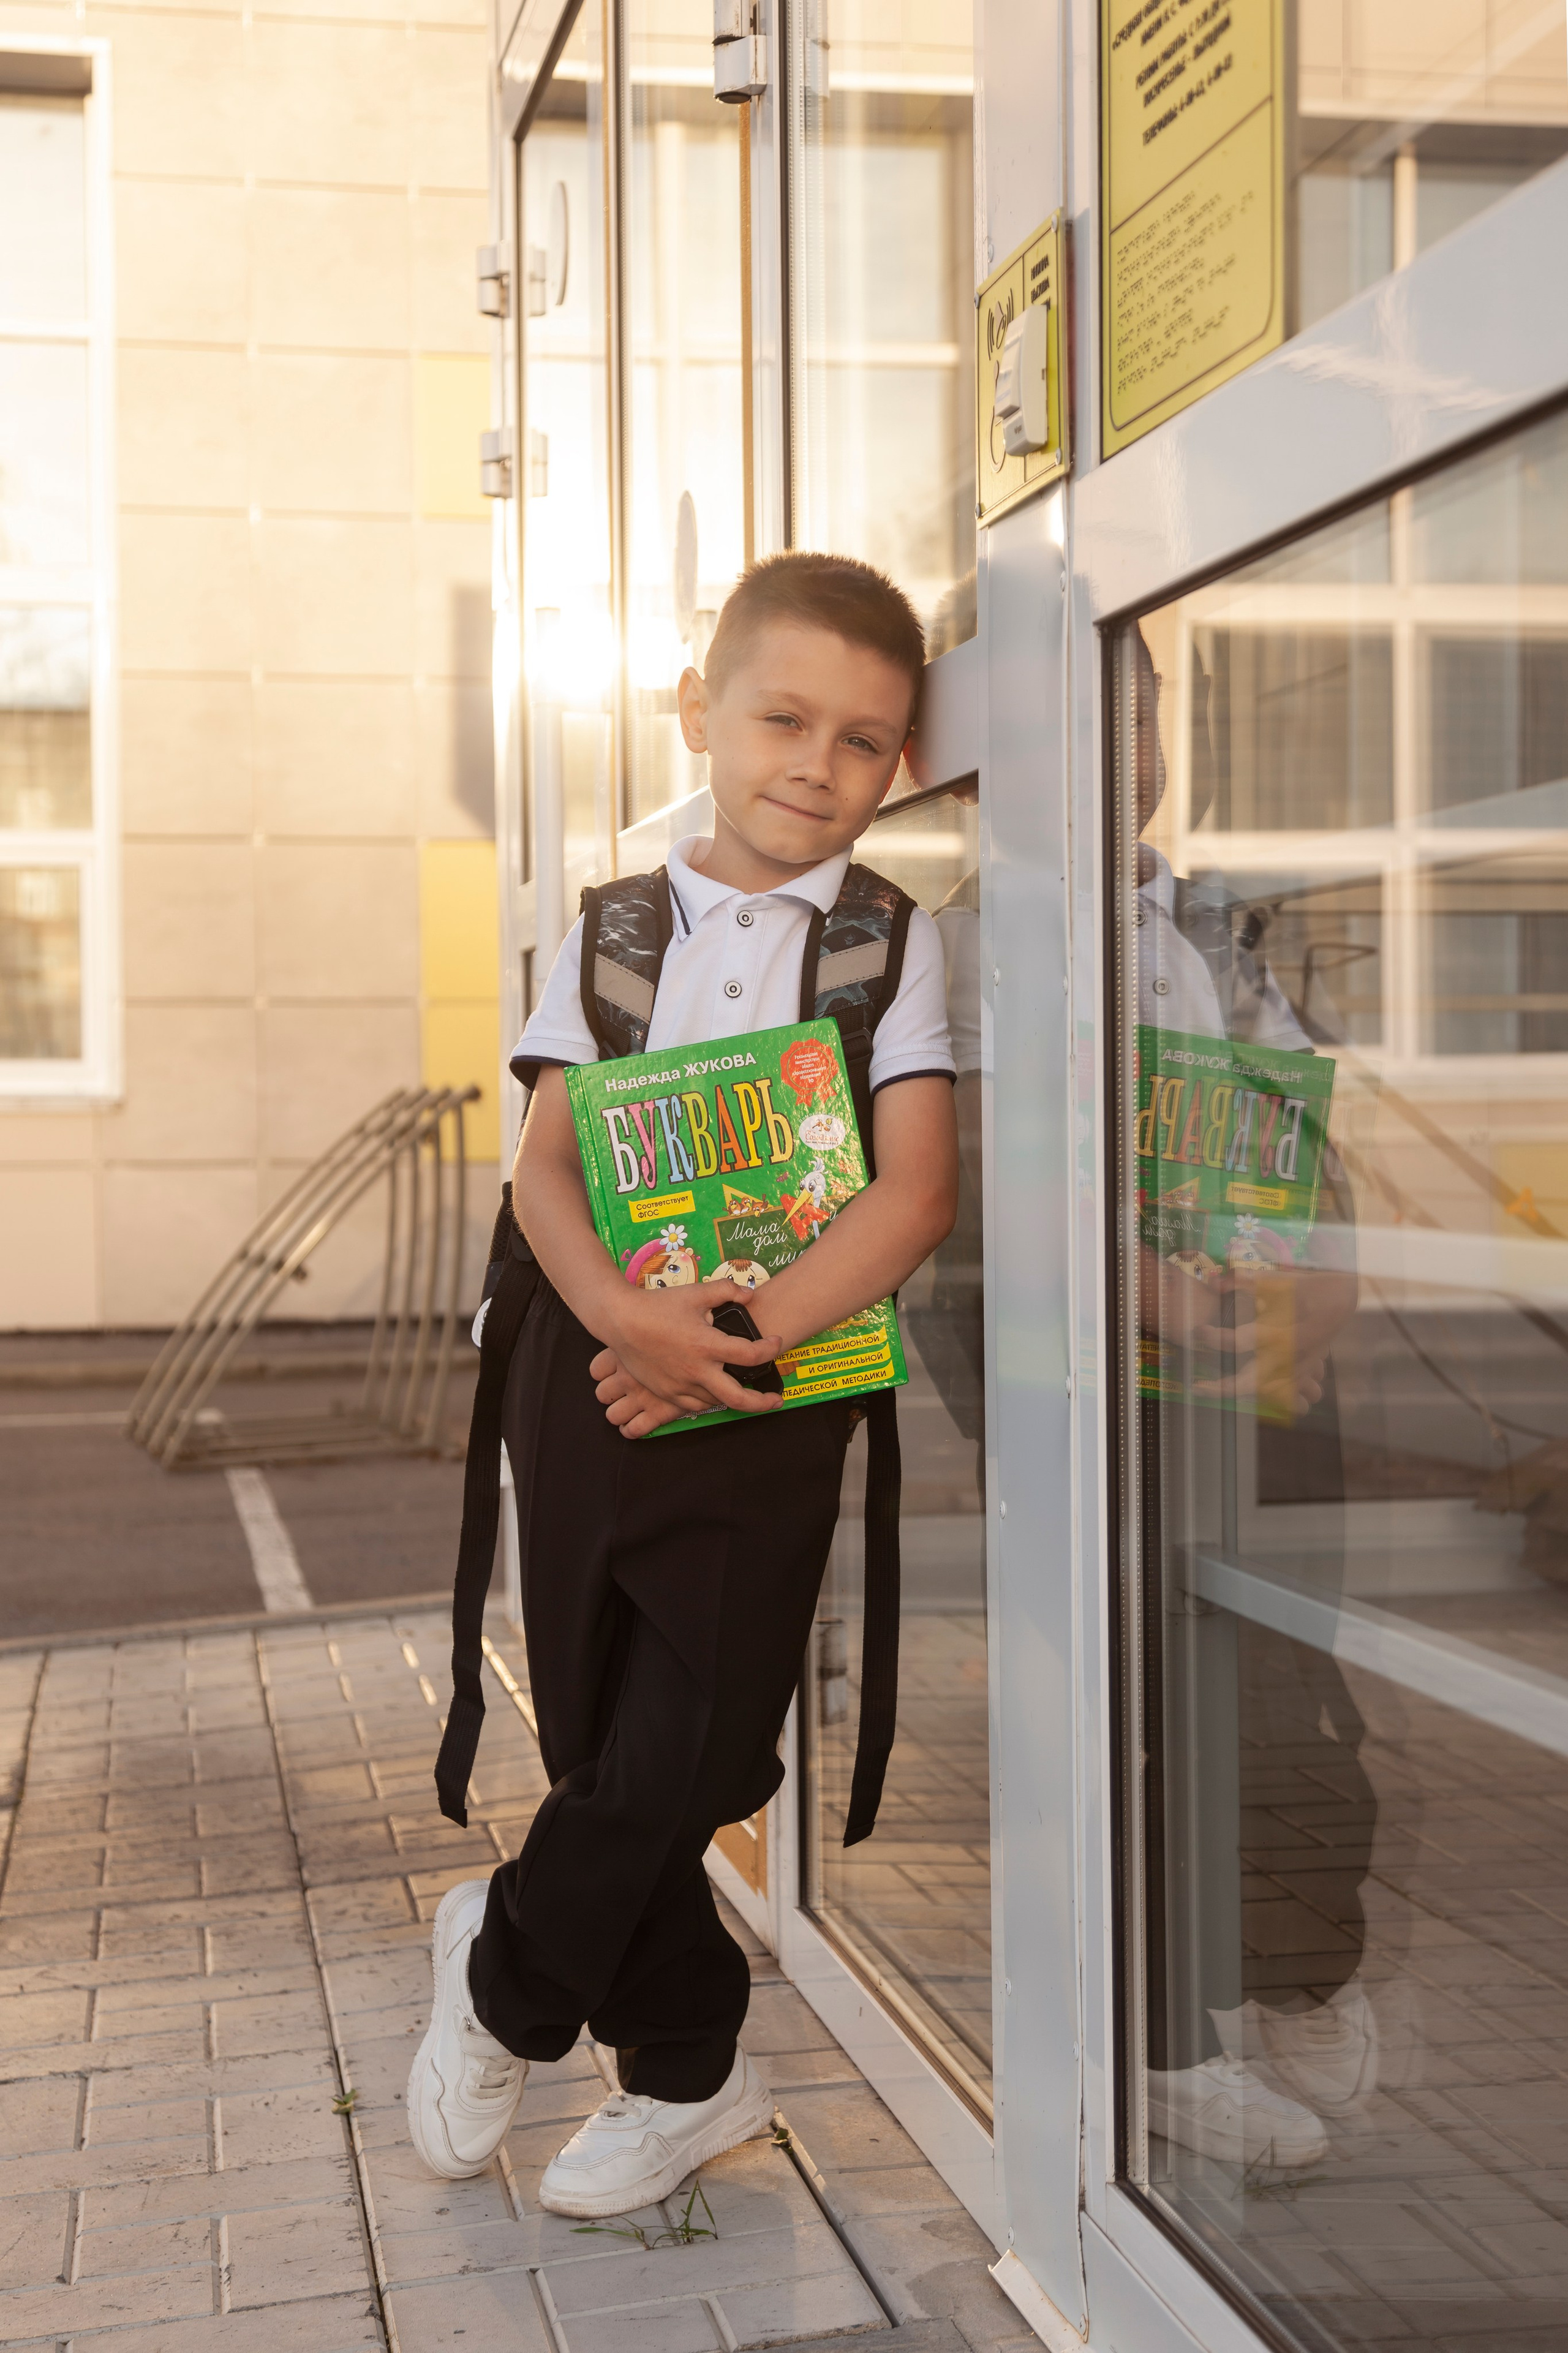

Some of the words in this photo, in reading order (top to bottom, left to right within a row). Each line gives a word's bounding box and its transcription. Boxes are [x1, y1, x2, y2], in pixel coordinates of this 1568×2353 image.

[605, 1069, 681, 1093] Надежда
[682, 1052, 757, 1078] ЖУКОВА
[600, 1076, 795, 1195] БУКВАРЬ
[636, 1196, 689, 1211] Соответствует
[638, 1209, 660, 1219] ФГОС
[726, 1221, 781, 1242] Мама
[753, 1232, 788, 1256] дом
[812, 1335, 880, 1354] ТРАДИЦИОННОЙ
[817, 1353, 883, 1372] ОРИГИНАЛЬНОЙ
[782, 1380, 837, 1397] ПЕДИЧЕСКОЙ
[842, 1370, 886, 1386] МЕТОДИКИ
